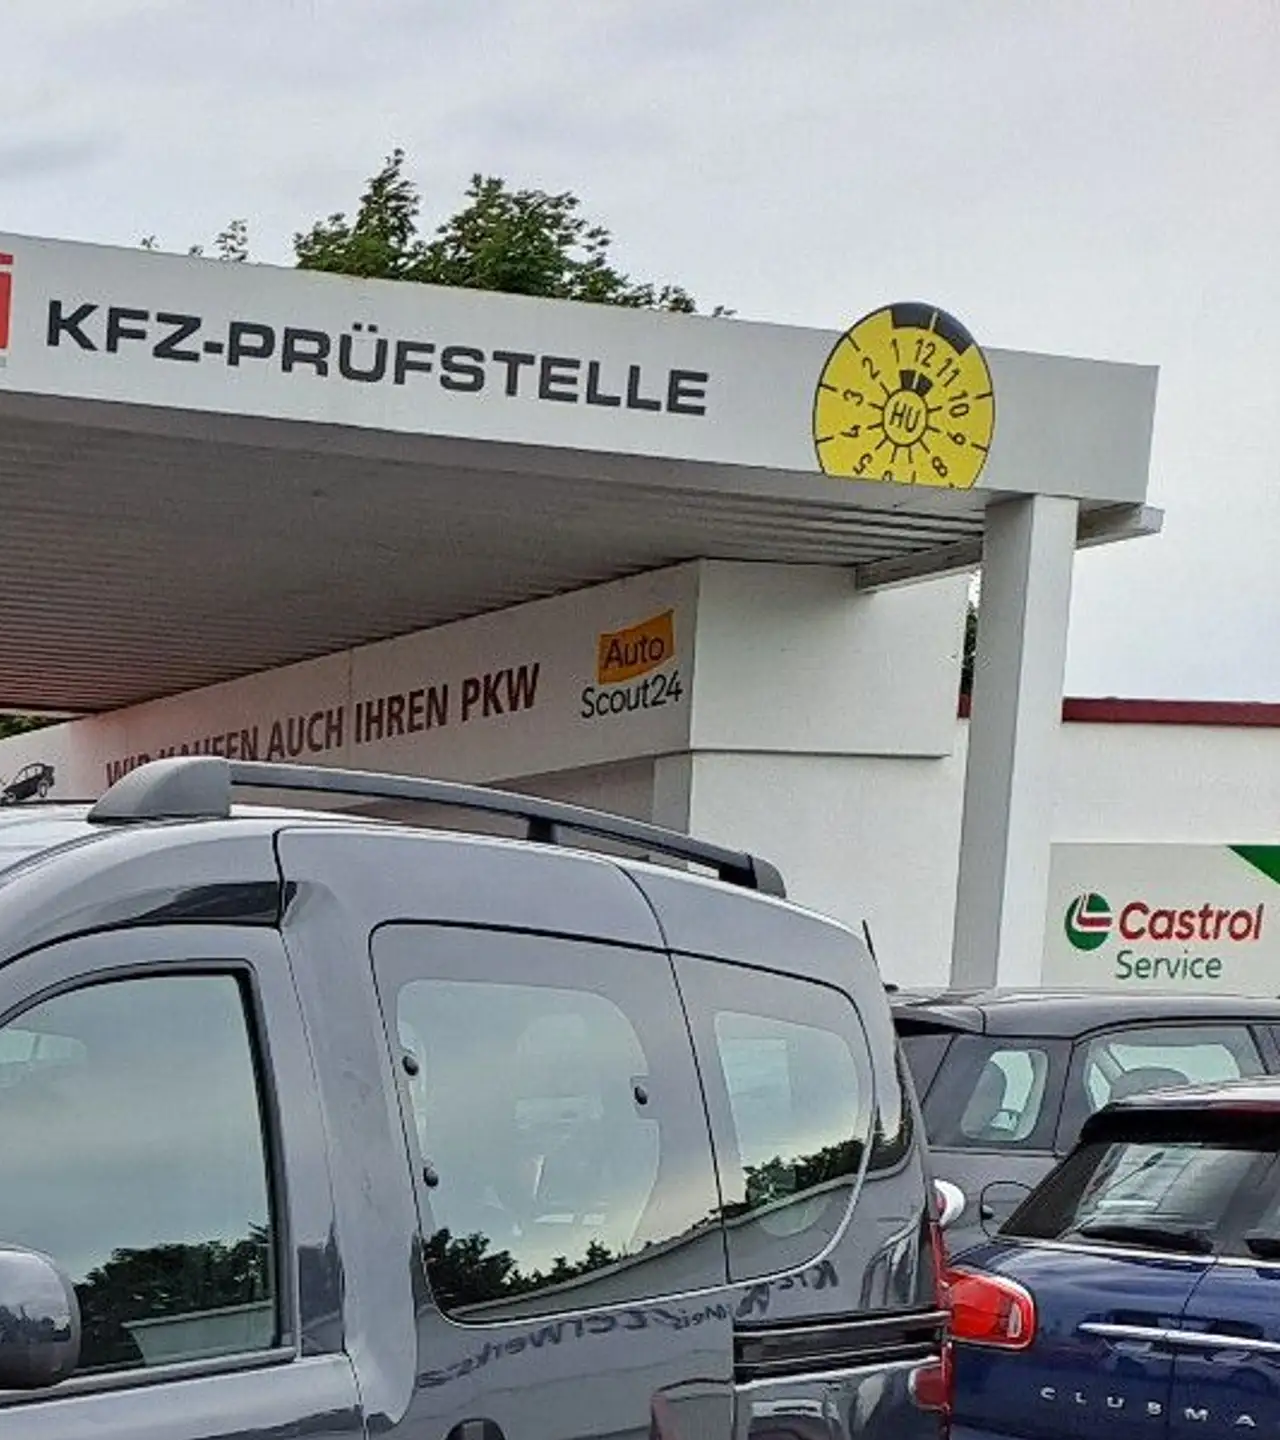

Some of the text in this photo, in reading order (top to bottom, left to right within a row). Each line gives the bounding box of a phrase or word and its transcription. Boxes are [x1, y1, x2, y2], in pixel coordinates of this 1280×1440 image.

[46, 299, 710, 418] KFZ-PRÜFSTELLE
[889, 401, 921, 433] HU
[603, 634, 666, 671] Auto
[266, 706, 344, 762] AUCH
[354, 684, 451, 745] IHREN
[461, 663, 541, 722] PKW
[581, 669, 684, 720] Scout24
[1118, 901, 1265, 941] Castrol
[1115, 949, 1223, 980] Service
